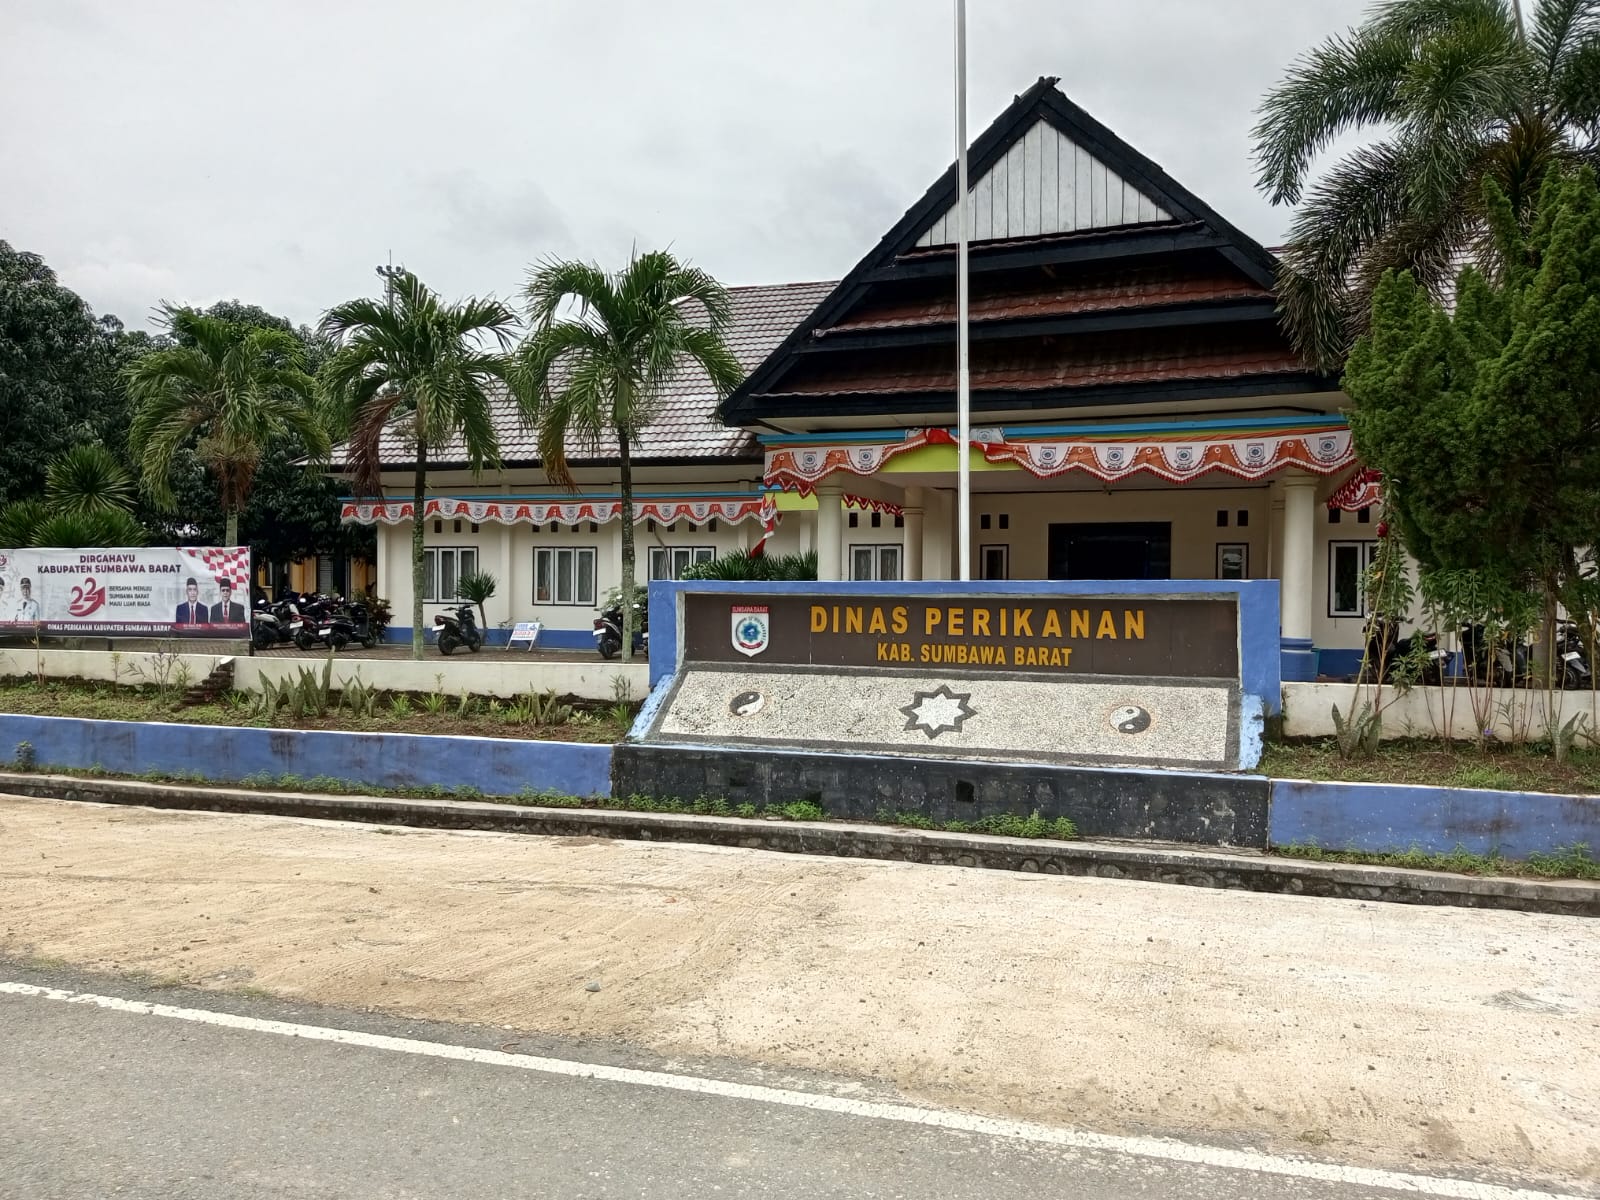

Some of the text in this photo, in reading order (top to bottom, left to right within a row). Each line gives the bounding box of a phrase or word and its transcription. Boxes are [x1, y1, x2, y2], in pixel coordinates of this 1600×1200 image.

[80, 554, 135, 563] DIRGAHAYU
[38, 564, 181, 574] KABUPATEN SUMBAWA BARAT
[125, 624, 152, 632] SUMBAWA
[811, 606, 1145, 640] DINAS PERIKANAN
[877, 642, 1072, 666] KAB. SUMBAWA BARAT
